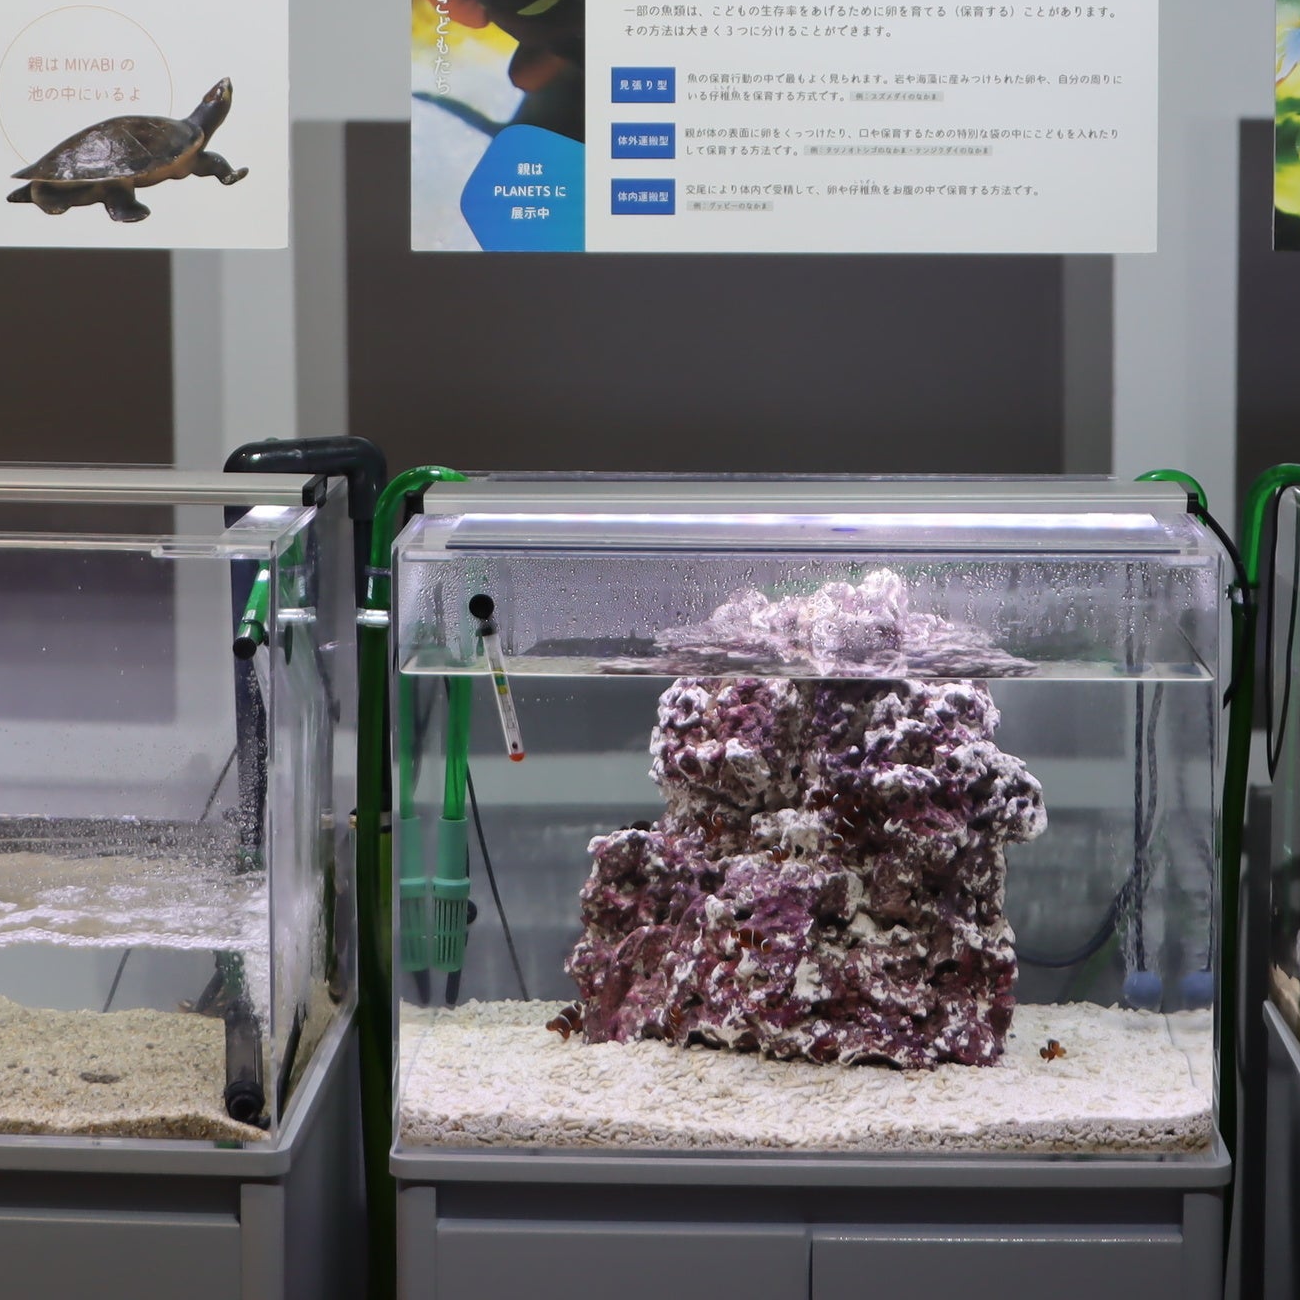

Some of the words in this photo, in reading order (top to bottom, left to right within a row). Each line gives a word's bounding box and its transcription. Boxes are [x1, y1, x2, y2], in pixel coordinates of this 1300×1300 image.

[27, 56, 59, 73] 親は
[64, 57, 115, 72] MIYABI
[120, 59, 135, 71] の
[619, 79, 668, 91] 見張り型
[28, 86, 141, 102] 池の中にいるよ
[617, 135, 669, 147] 体外運搬型
[517, 162, 543, 176] 親は
[494, 185, 551, 197] PLANETS
[555, 185, 566, 197] に
[617, 191, 669, 203] 体内運搬型
[510, 206, 550, 220] 展示中
